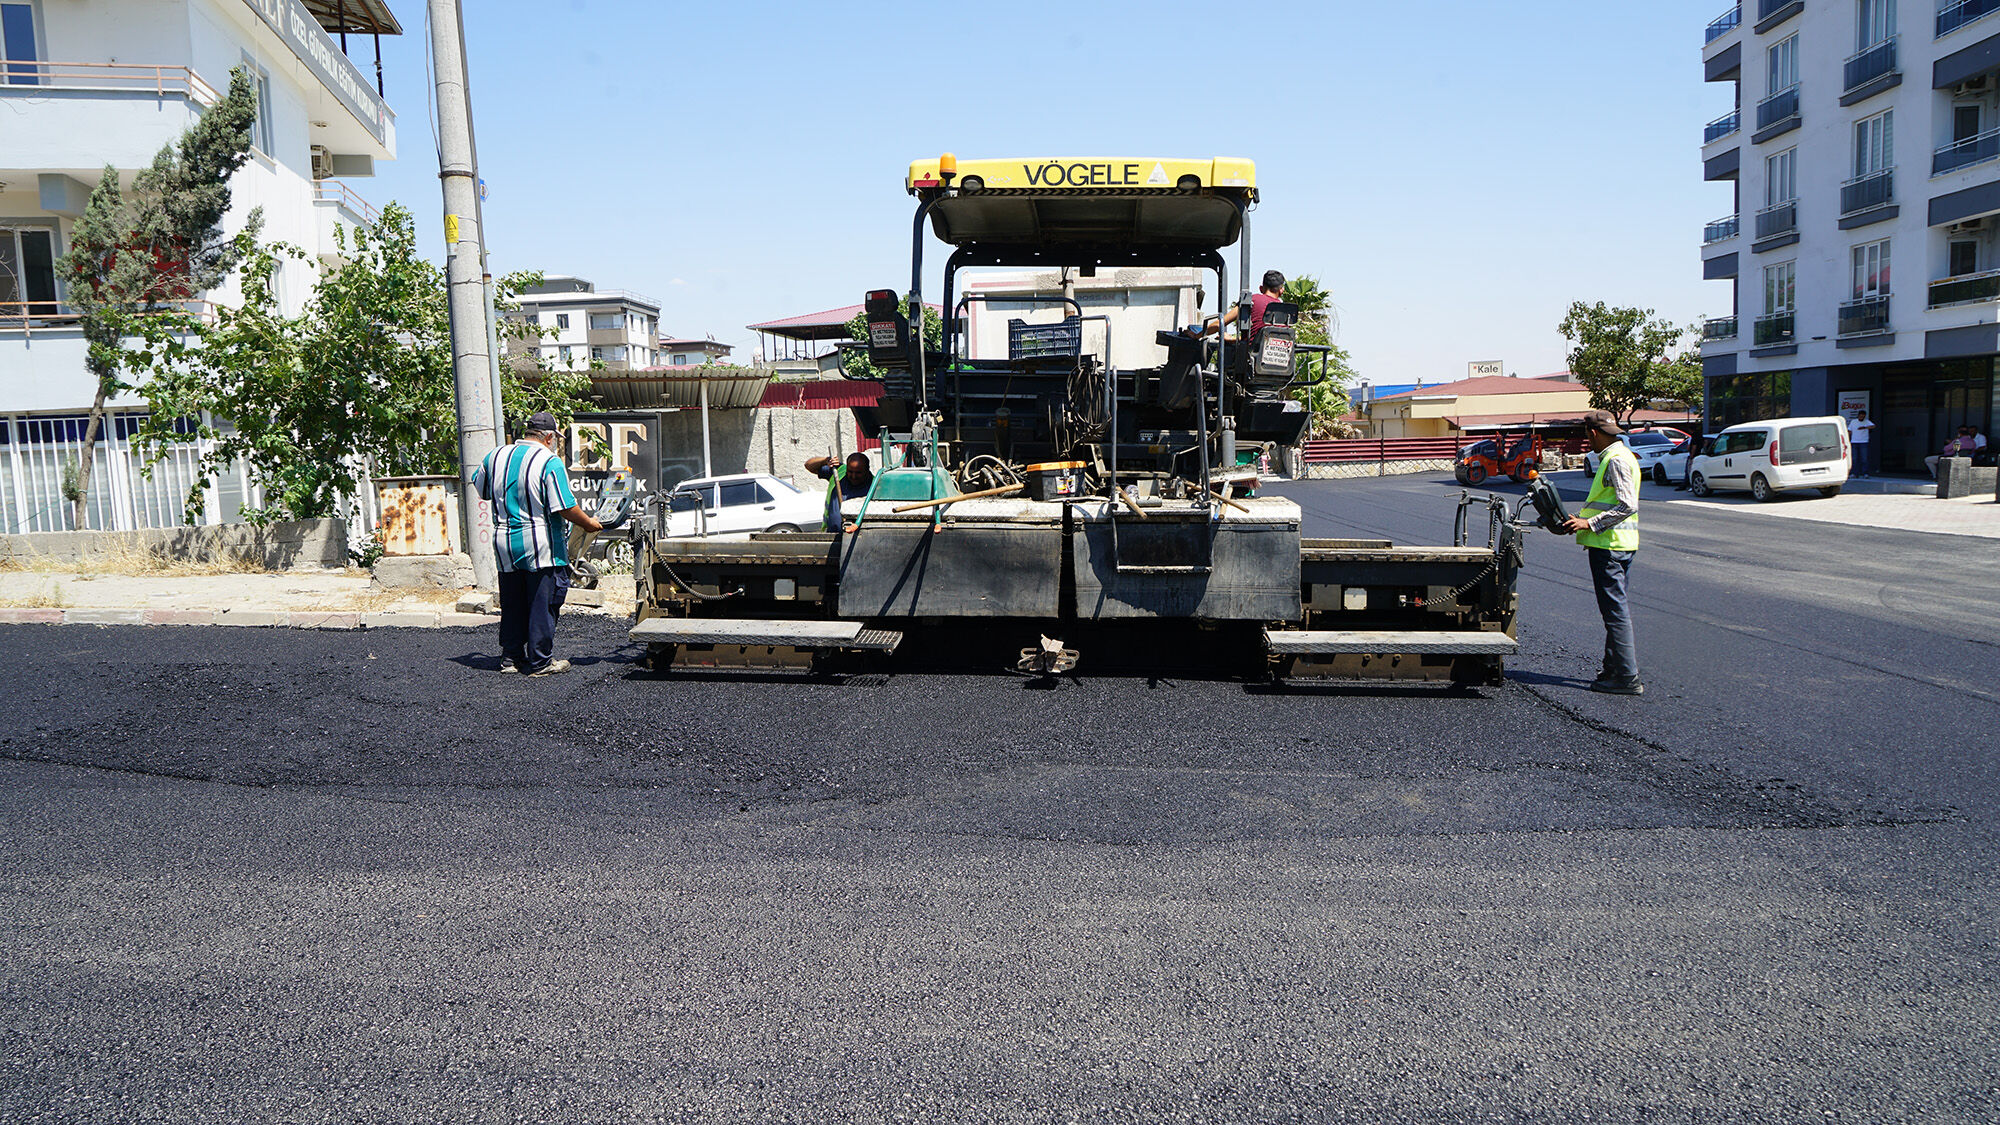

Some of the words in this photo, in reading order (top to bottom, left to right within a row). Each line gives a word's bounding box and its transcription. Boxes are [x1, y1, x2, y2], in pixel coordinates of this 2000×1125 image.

[290, 2, 309, 50] ÖZEL
[1023, 160, 1139, 186] VÖGELE
[1477, 365, 1498, 373] Kale
[557, 423, 647, 471] EF
[569, 476, 647, 492] GÜVK
[478, 497, 491, 544] 020
